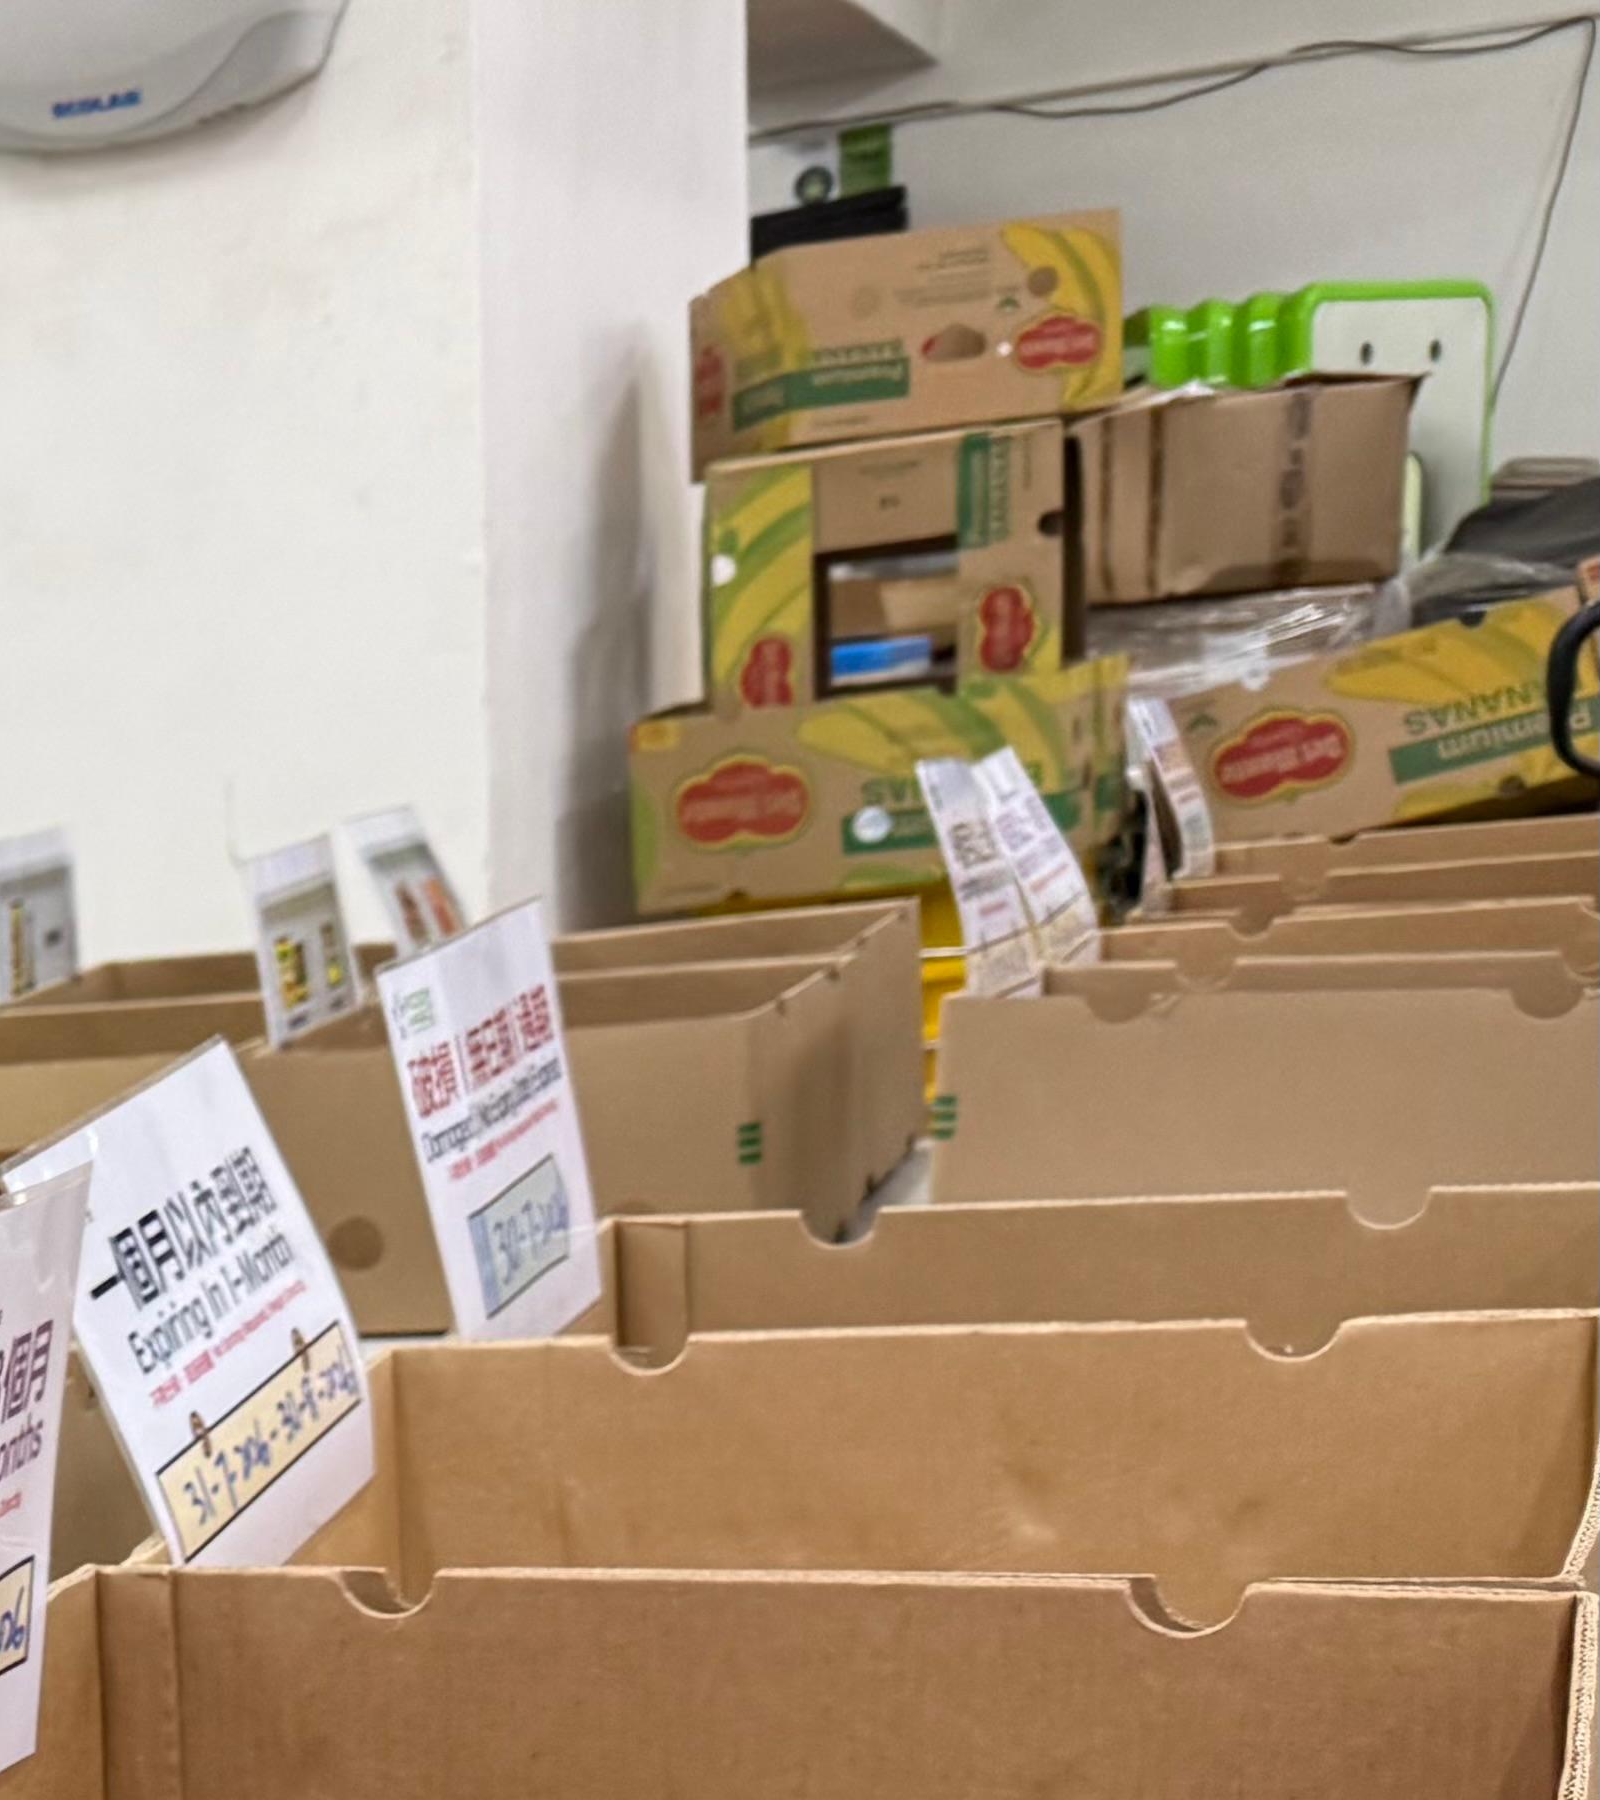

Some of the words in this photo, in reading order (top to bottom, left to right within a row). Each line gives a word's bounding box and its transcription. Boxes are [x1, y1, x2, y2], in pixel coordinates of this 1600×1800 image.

[90, 1146, 277, 1312] 一個月以內到期
[127, 1298, 214, 1375] Expiring
